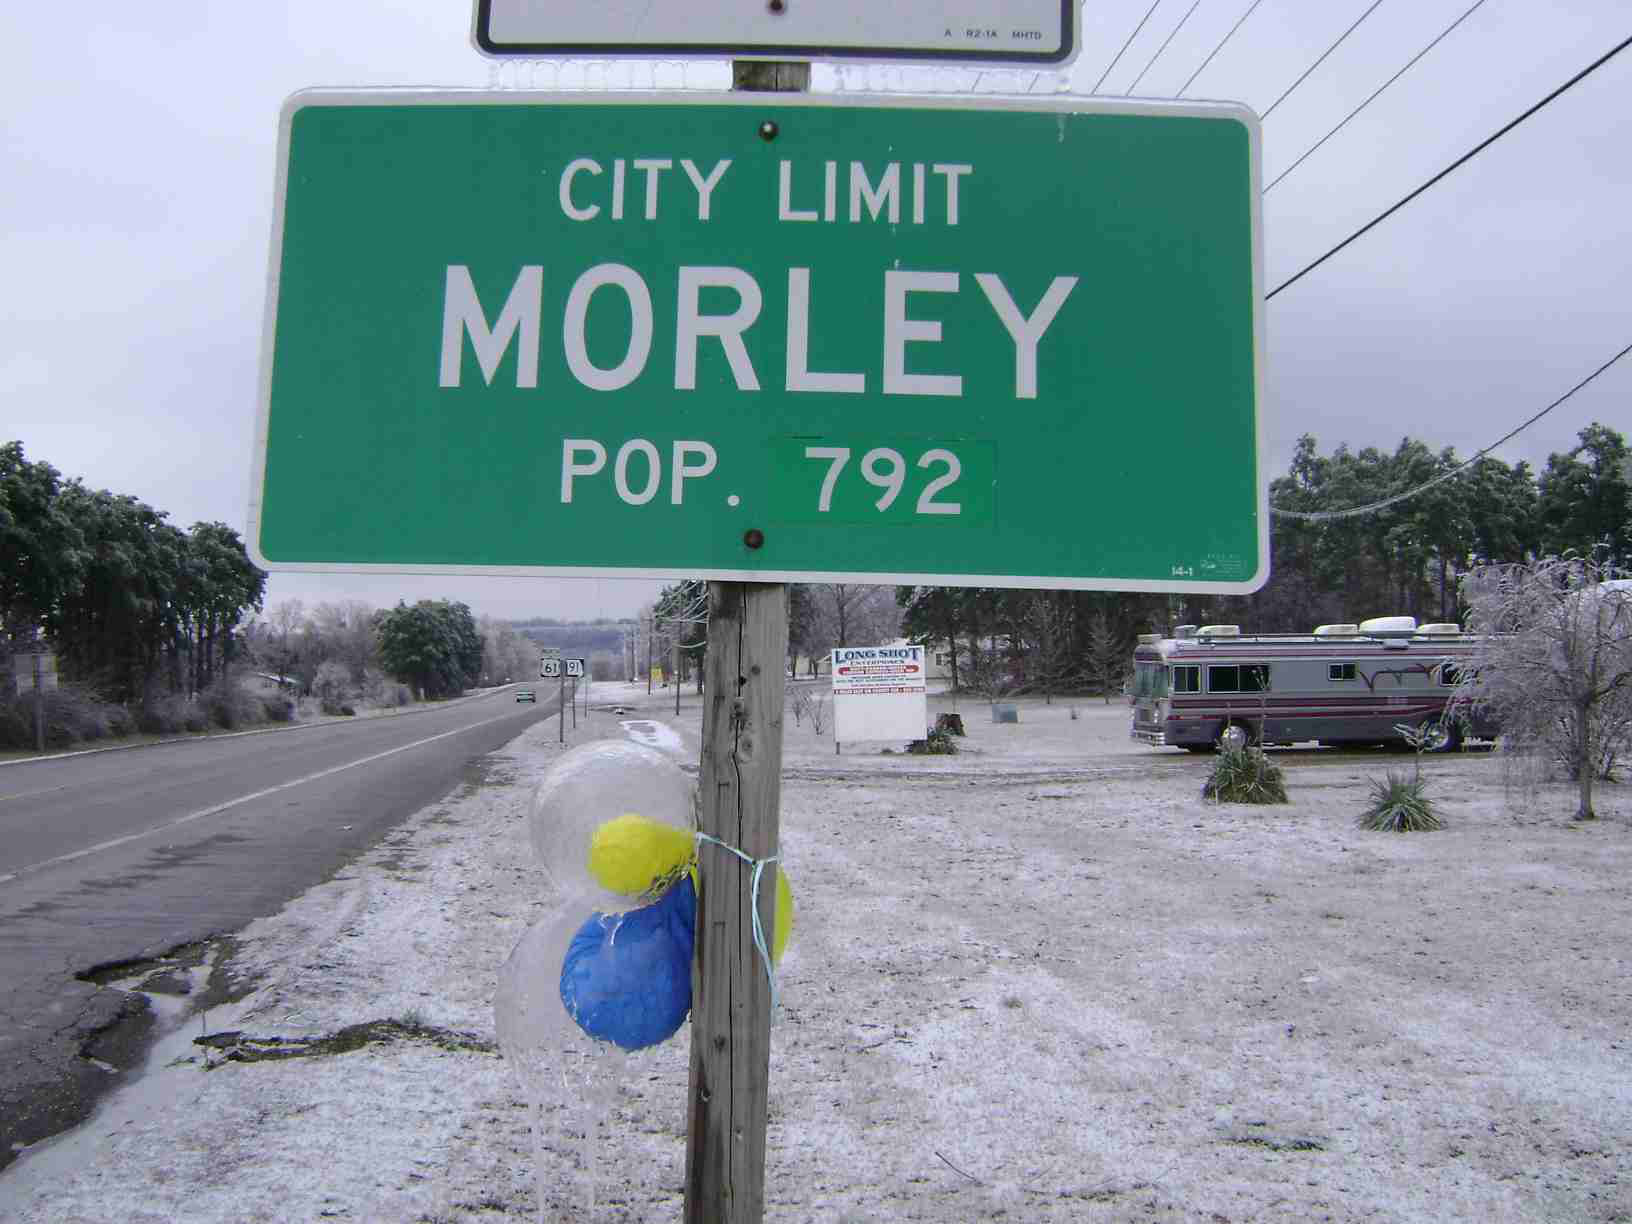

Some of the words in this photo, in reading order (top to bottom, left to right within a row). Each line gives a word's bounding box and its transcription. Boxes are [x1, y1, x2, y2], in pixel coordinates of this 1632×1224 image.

[558, 158, 733, 222] CITY
[777, 159, 974, 226] LIMIT
[438, 262, 1080, 401] MORLEY
[560, 437, 742, 508] POP.
[804, 445, 964, 517] 792
[835, 650, 876, 664] LONG
[879, 647, 920, 661] SHOT
